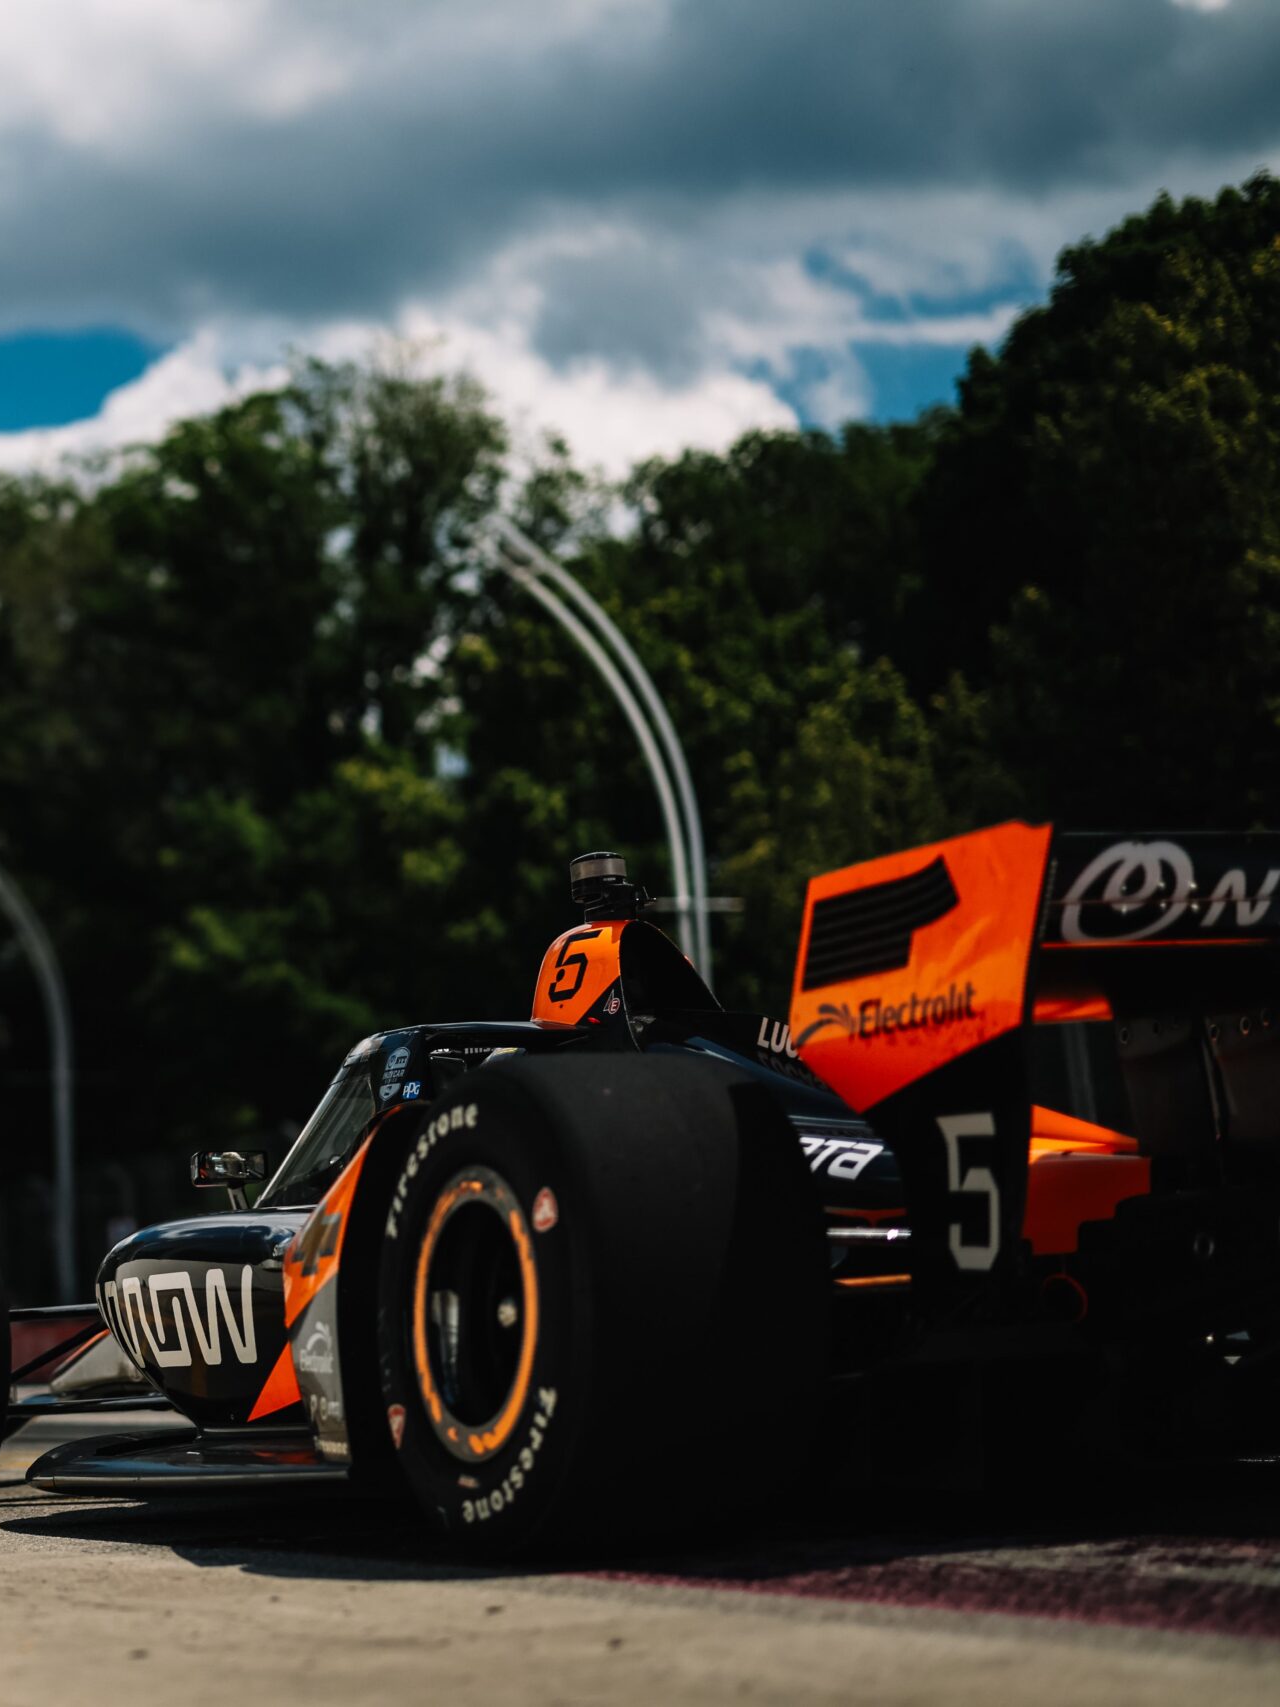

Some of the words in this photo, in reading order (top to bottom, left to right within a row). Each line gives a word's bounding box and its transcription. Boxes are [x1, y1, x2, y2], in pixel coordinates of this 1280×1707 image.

[548, 929, 603, 1003] 5
[859, 981, 976, 1039] Electrolit
[403, 1082, 420, 1098] PPG
[386, 1103, 478, 1239] Firestone
[936, 1112, 1000, 1270] 5
[462, 1387, 557, 1523] Firestone
